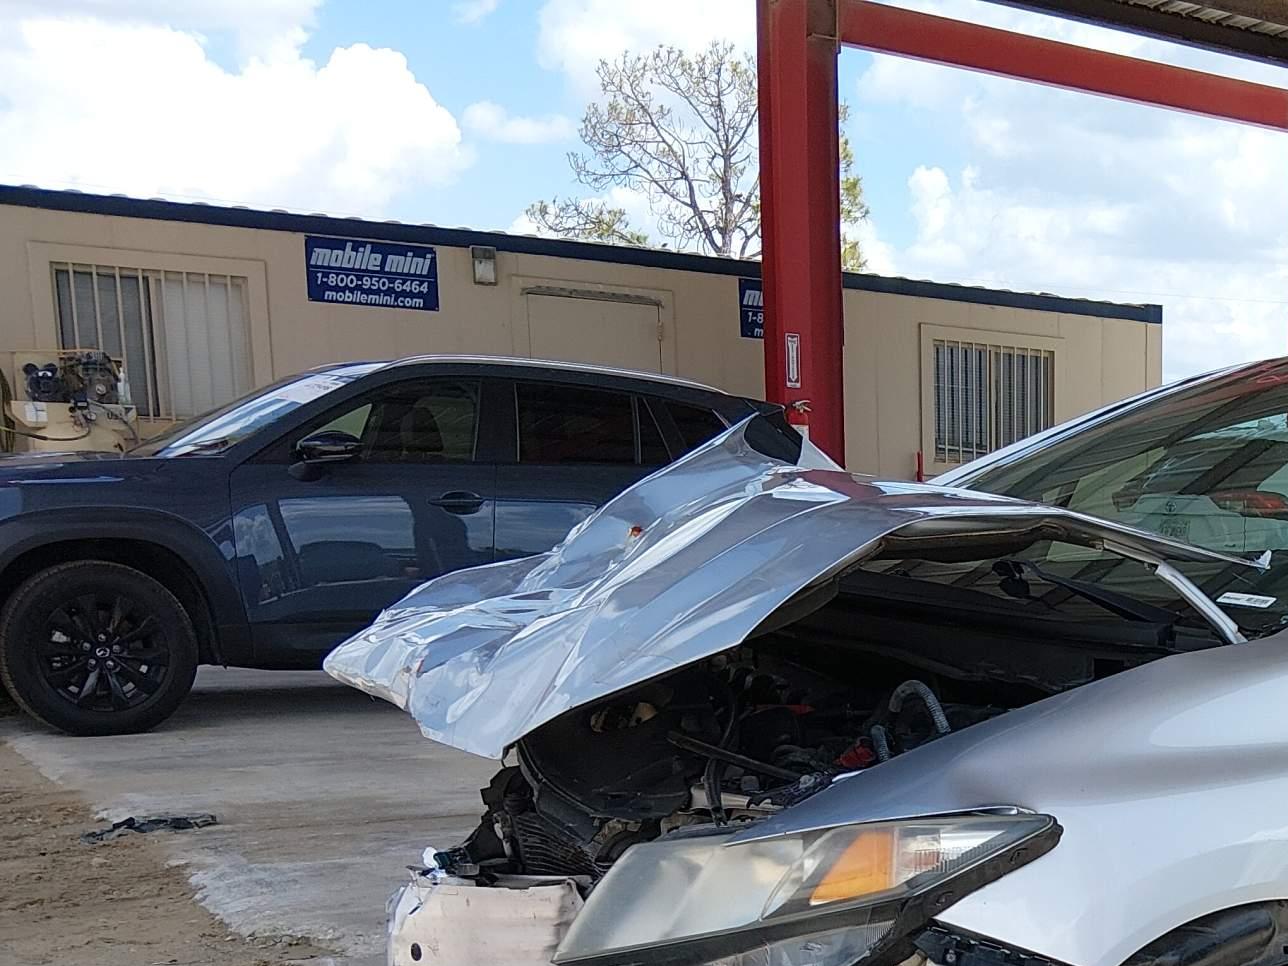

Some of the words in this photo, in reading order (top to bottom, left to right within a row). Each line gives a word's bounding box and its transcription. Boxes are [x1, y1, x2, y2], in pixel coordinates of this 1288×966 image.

[310, 242, 382, 271] mobile
[384, 252, 433, 275] mini
[316, 272, 429, 294] 1-800-950-6464
[324, 290, 424, 308] mobilemini.com
[743, 289, 764, 307] m
